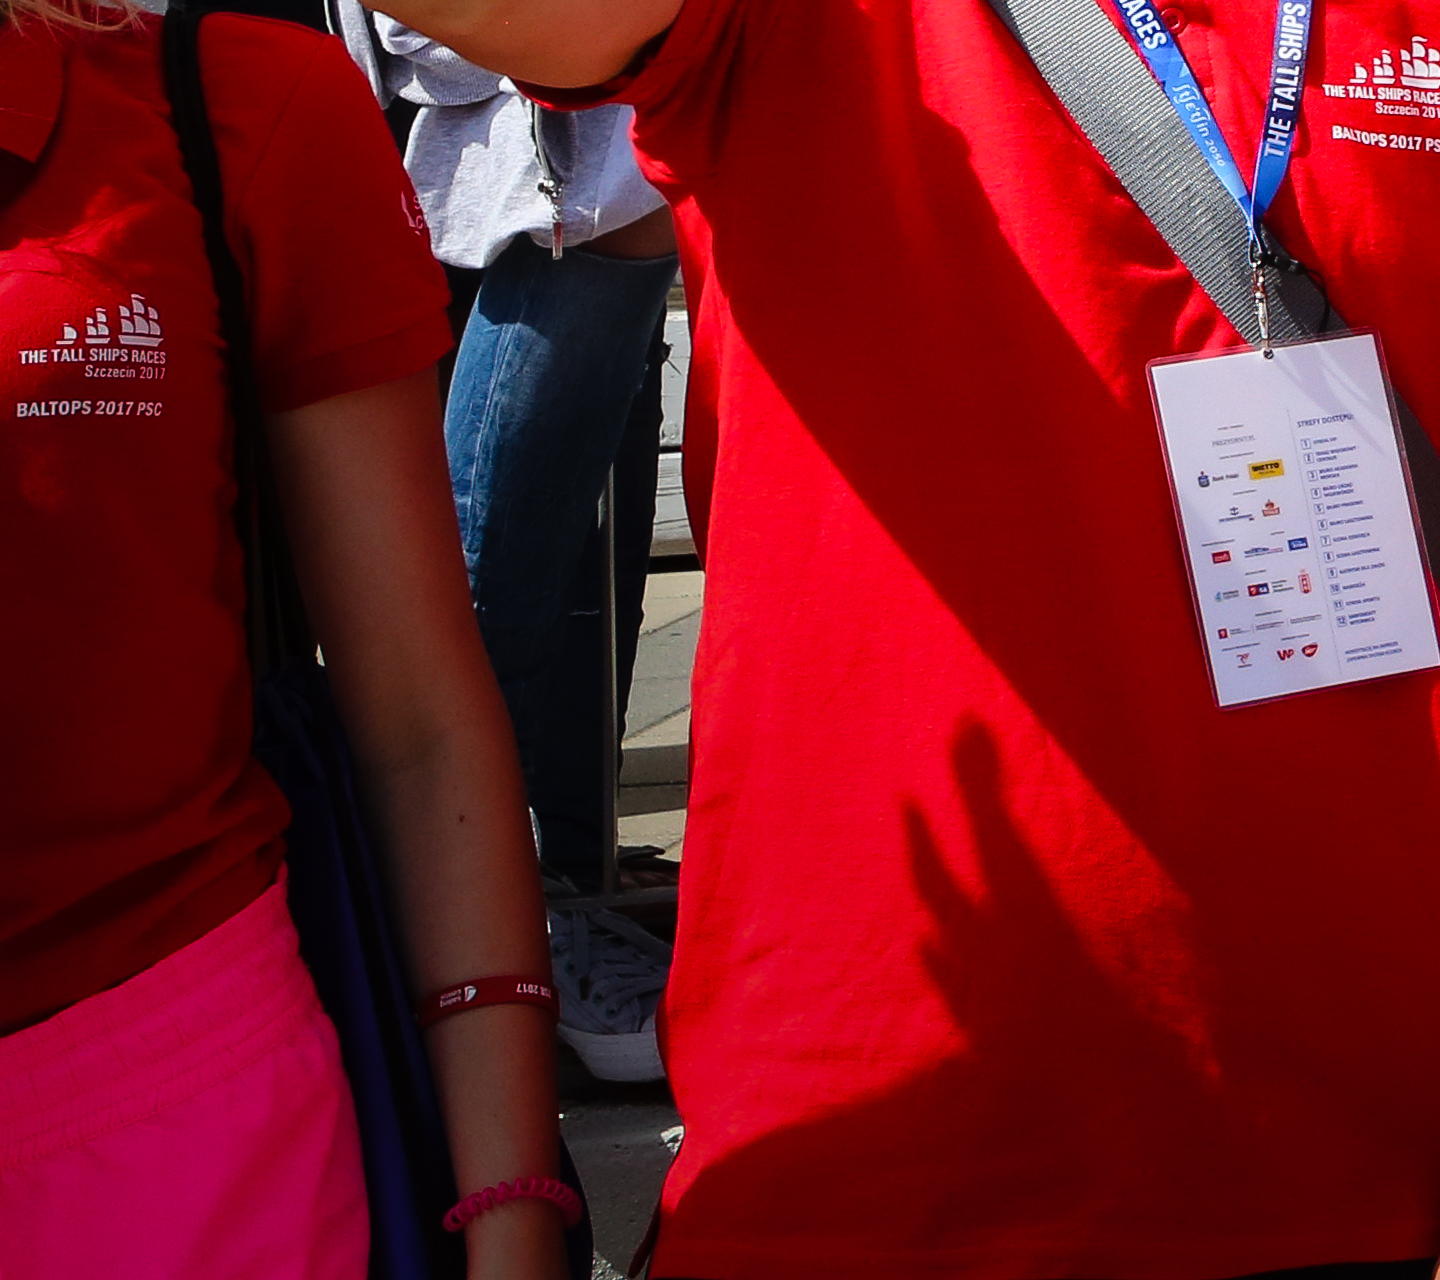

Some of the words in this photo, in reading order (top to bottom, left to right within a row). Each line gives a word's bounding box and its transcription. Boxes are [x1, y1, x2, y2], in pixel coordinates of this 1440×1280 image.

[1278, 1, 1307, 67] SHIPS
[1271, 64, 1300, 113] TALL
[1322, 83, 1347, 98] THE
[1346, 84, 1377, 100] TALL
[1377, 87, 1412, 102] SHIPS
[1375, 101, 1420, 117] Szczecin
[1264, 111, 1292, 158] THE
[1331, 124, 1388, 148] BALTOPS
[1388, 133, 1422, 151] 2017
[19, 349, 48, 365] THE
[51, 348, 86, 362] TALL
[89, 348, 129, 362] SHIPS
[131, 349, 167, 365] RACES
[84, 364, 136, 378] Szczecin
[139, 366, 166, 380] 2017
[16, 400, 92, 418] BALTOPS
[95, 400, 135, 416] 2017
[136, 401, 163, 417] PSC
[516, 982, 539, 994] 2017
